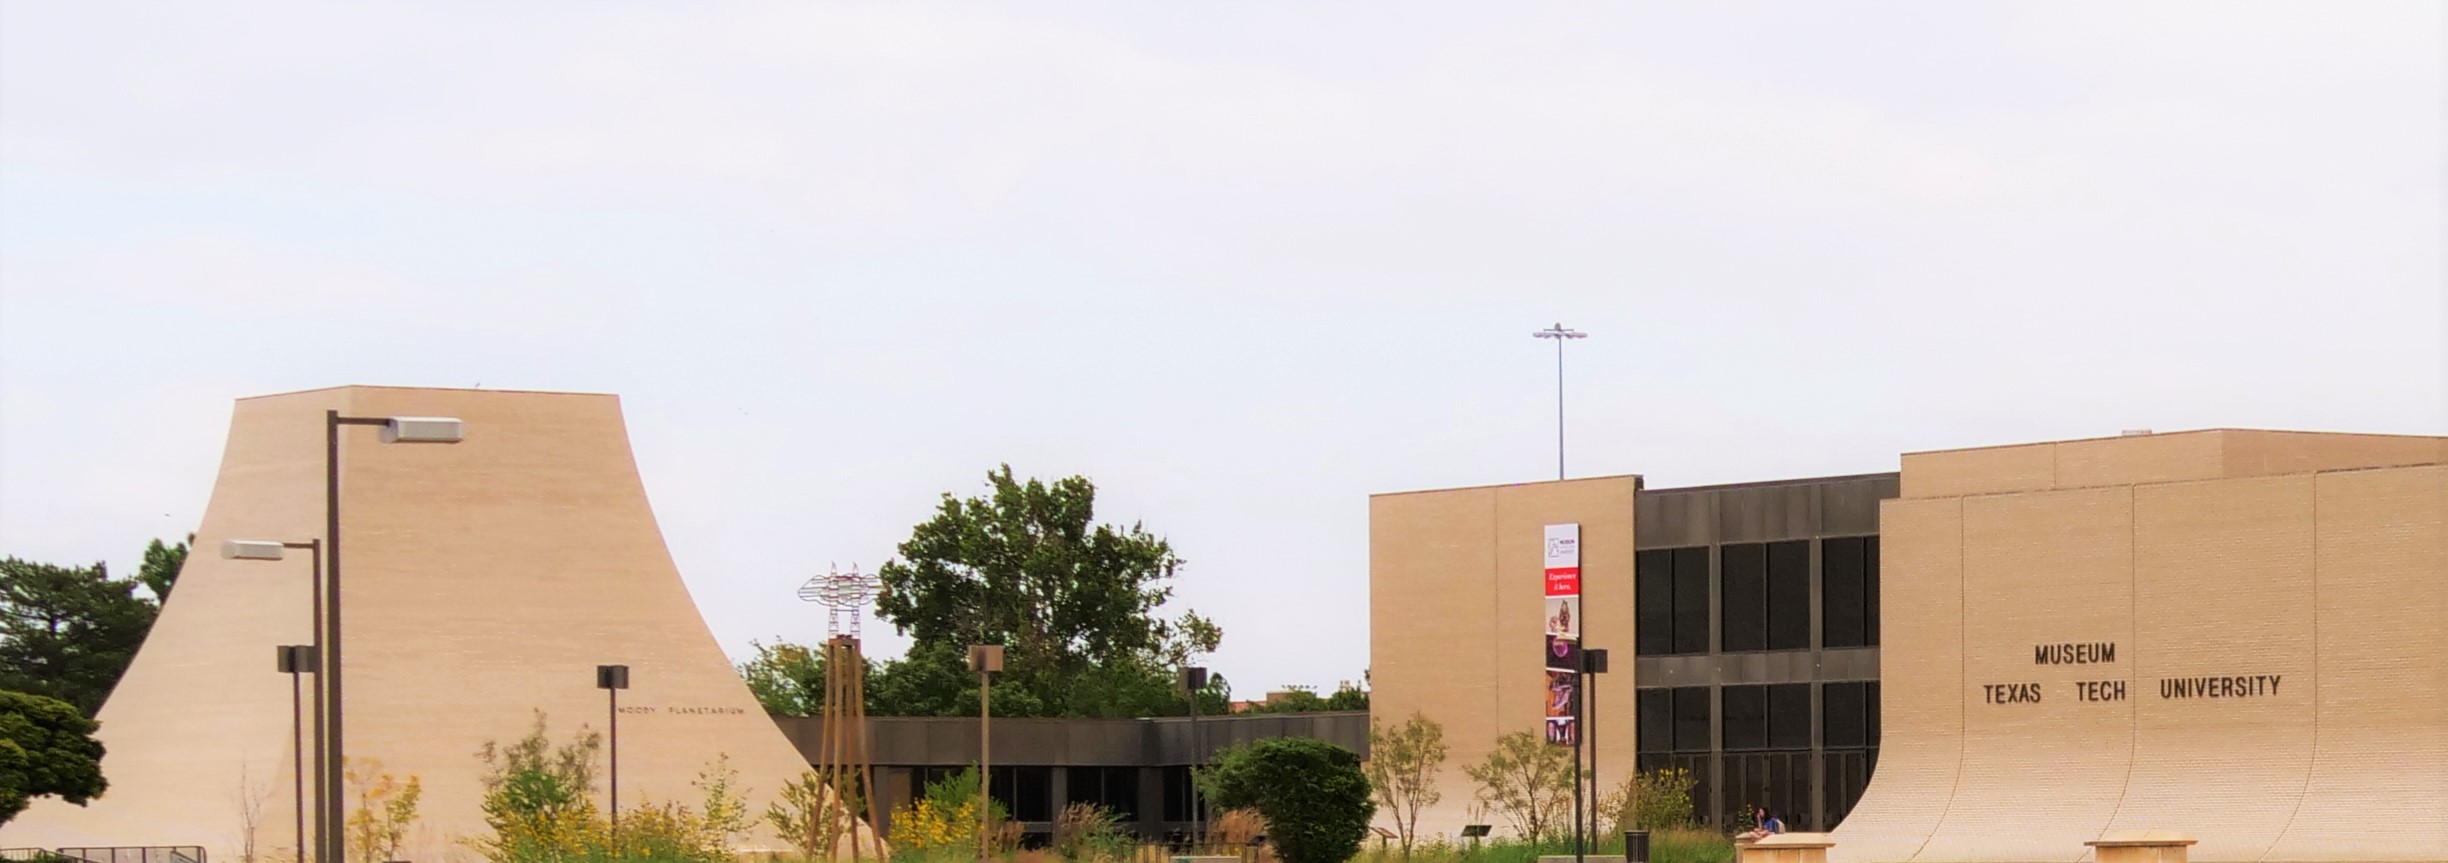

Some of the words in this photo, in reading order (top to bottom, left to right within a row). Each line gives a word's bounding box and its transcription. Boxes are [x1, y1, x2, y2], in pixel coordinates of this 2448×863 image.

[2035, 642, 2115, 665] MUSEUM
[1984, 683, 2041, 704] TEXAS
[2076, 680, 2125, 702] TECH
[2160, 675, 2281, 700] UNIVERSITY
[618, 706, 656, 714] MOODY
[669, 706, 745, 715] PLANETARIUM
